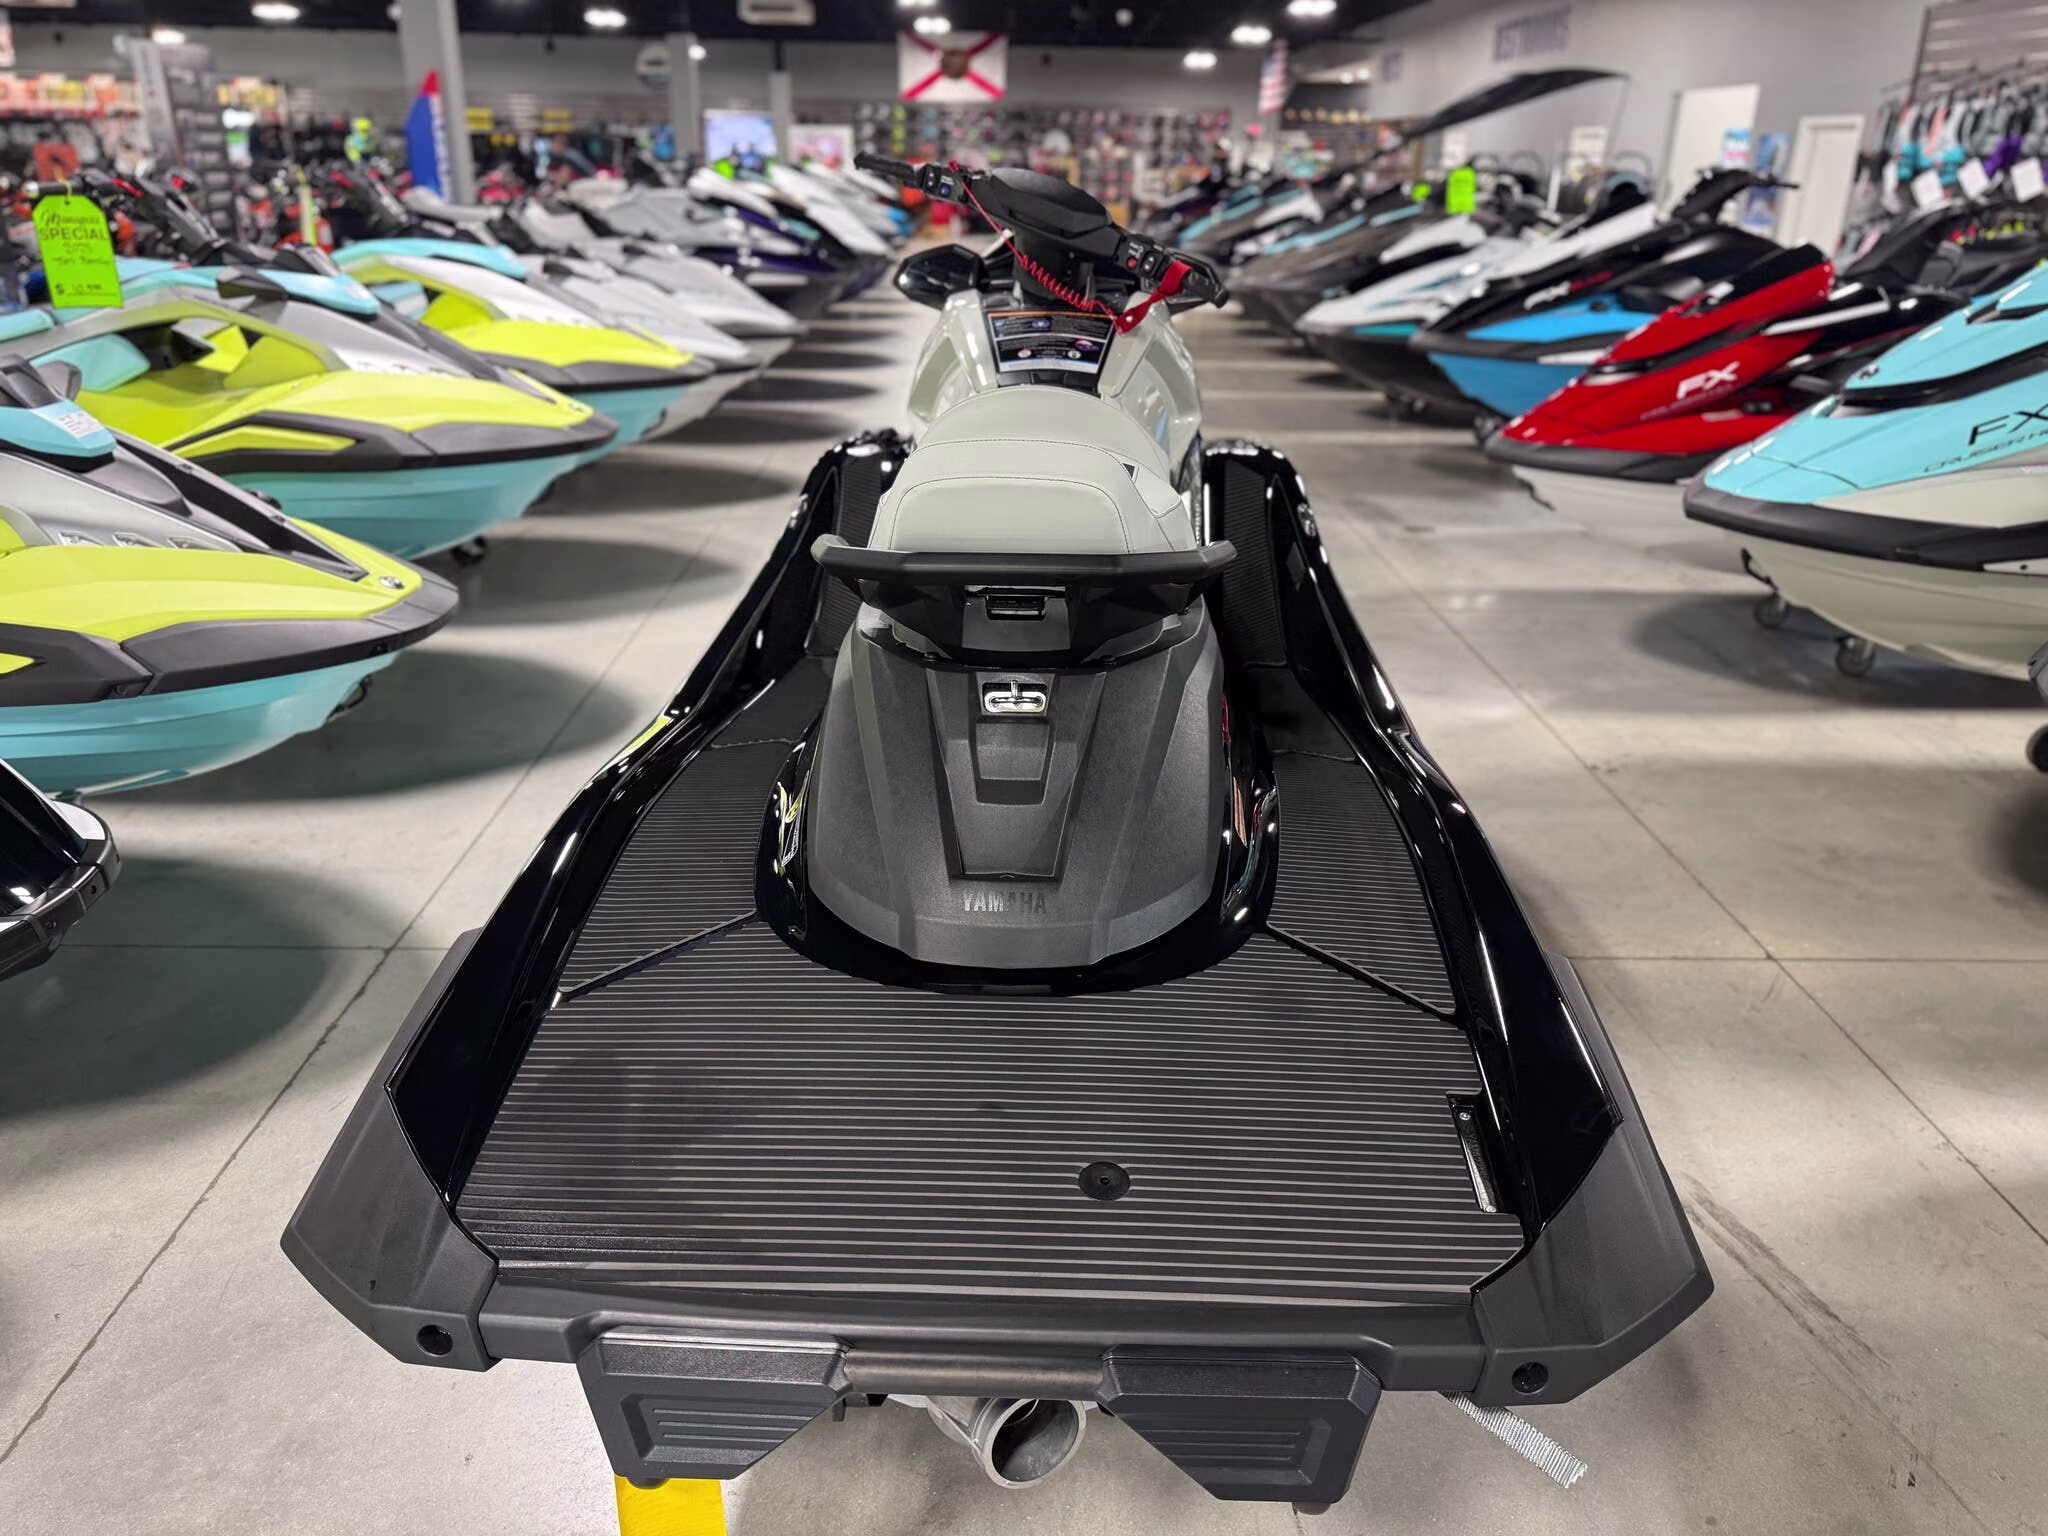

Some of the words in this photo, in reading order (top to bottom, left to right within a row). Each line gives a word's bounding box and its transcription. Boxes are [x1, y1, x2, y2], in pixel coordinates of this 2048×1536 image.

[39, 227, 107, 241] SPECIAL
[1676, 360, 1741, 400] FX
[1968, 403, 2048, 447] FX
[962, 890, 1047, 914] YAMAHA
